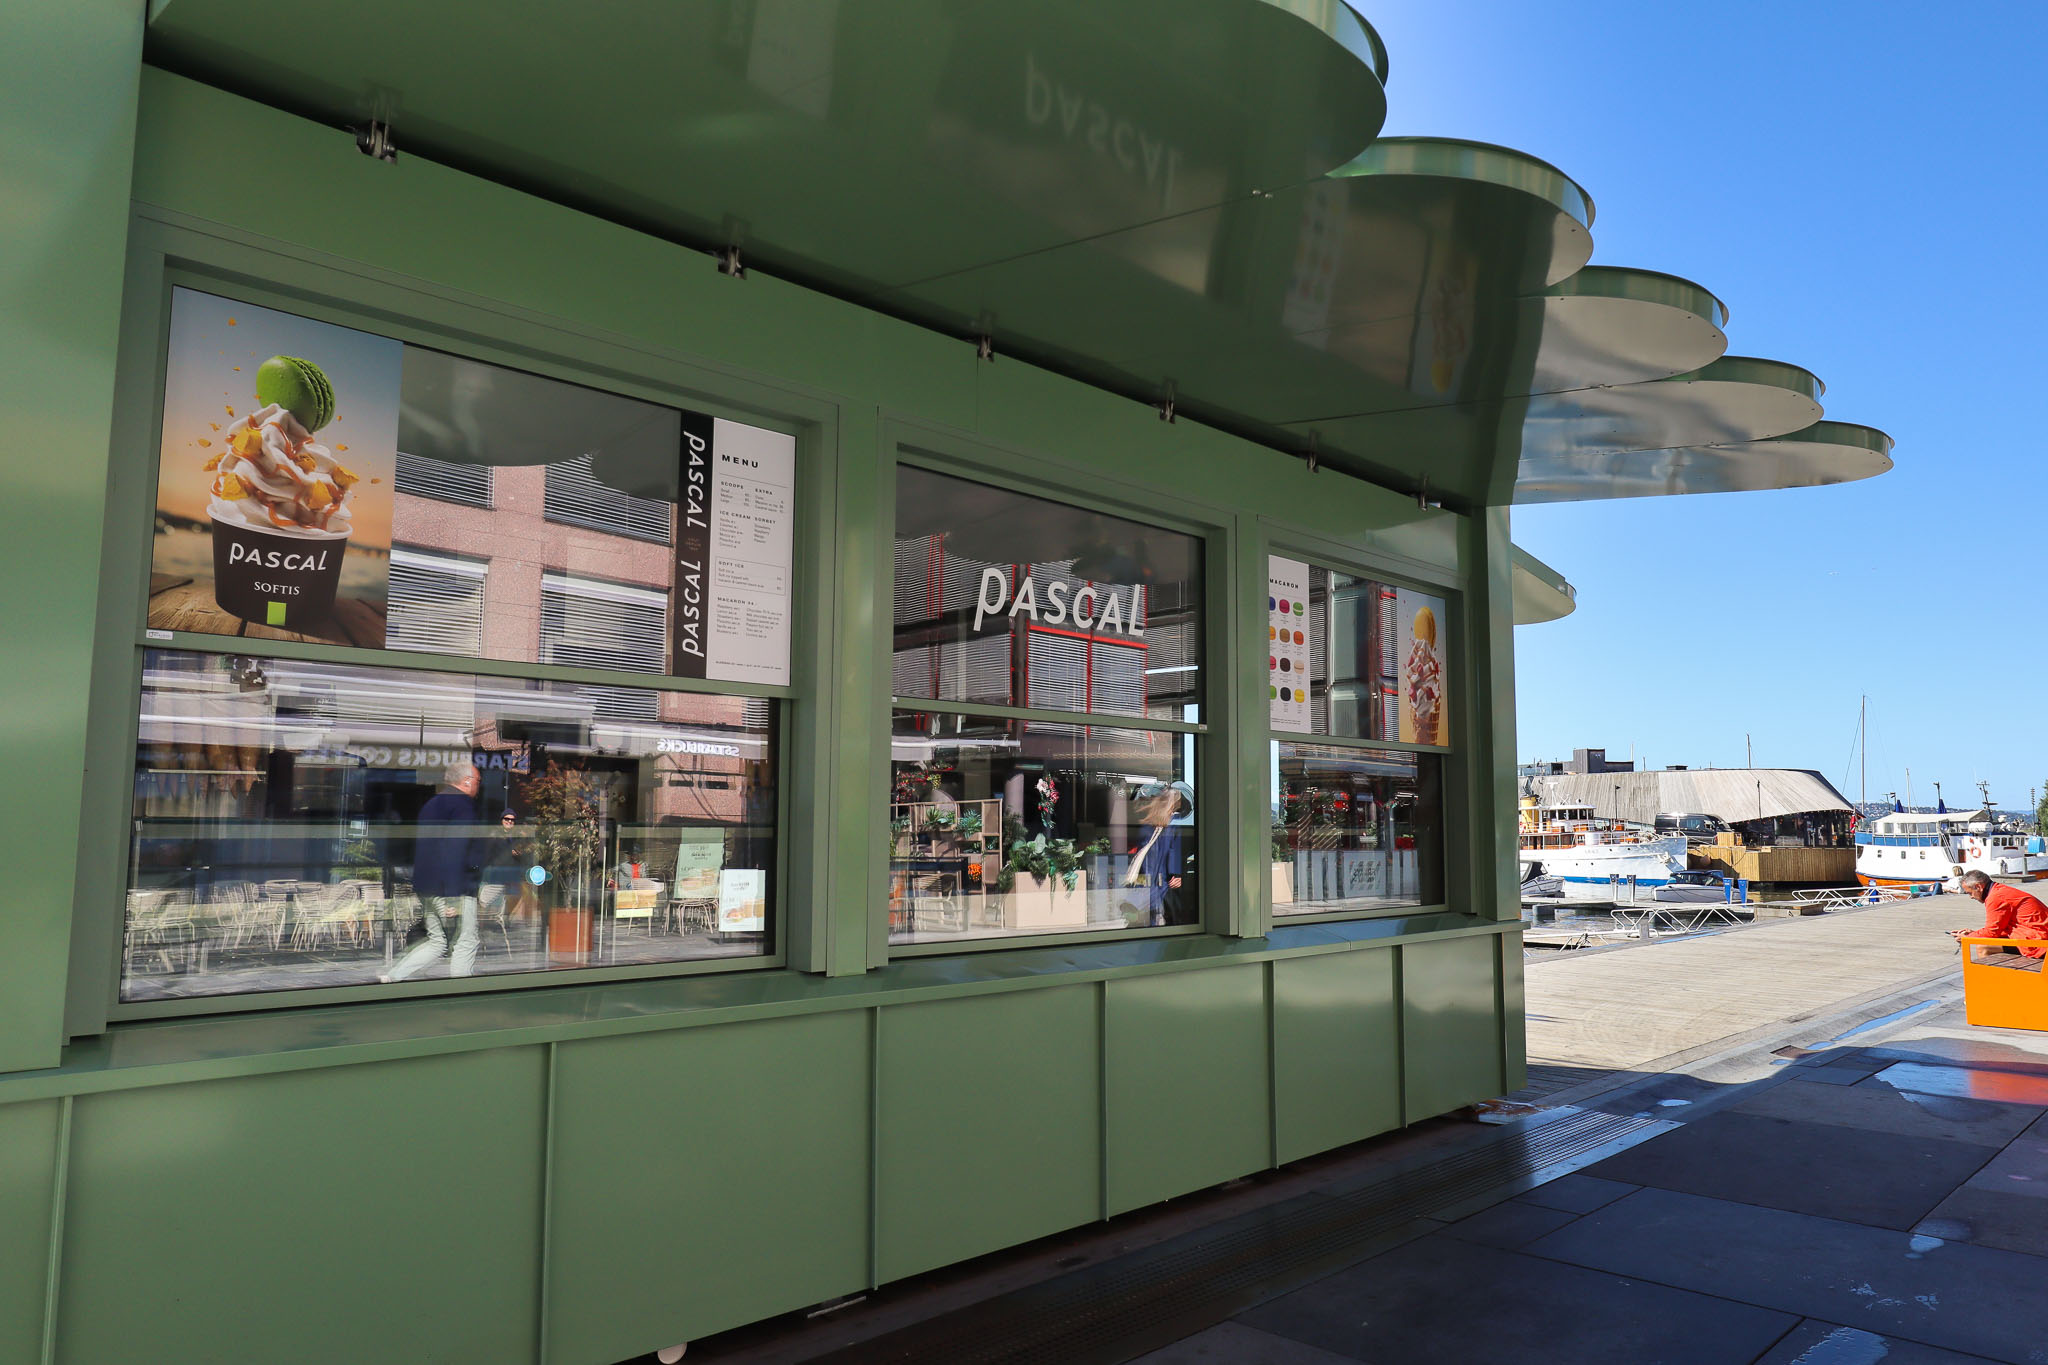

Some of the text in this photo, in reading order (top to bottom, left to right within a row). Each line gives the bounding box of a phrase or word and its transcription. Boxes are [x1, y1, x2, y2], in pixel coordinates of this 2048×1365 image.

[721, 453, 759, 469] MENU
[684, 431, 707, 528] PASCAL
[720, 480, 744, 490] SCOOPS
[731, 512, 751, 520] CREAM
[229, 542, 327, 571] PASCAL
[254, 581, 300, 596] SOFTIS
[1269, 577, 1299, 590] MACARON
[717, 596, 746, 605] MACARON
[973, 567, 1145, 637] PASCAL
[680, 560, 705, 658] PASCAL
